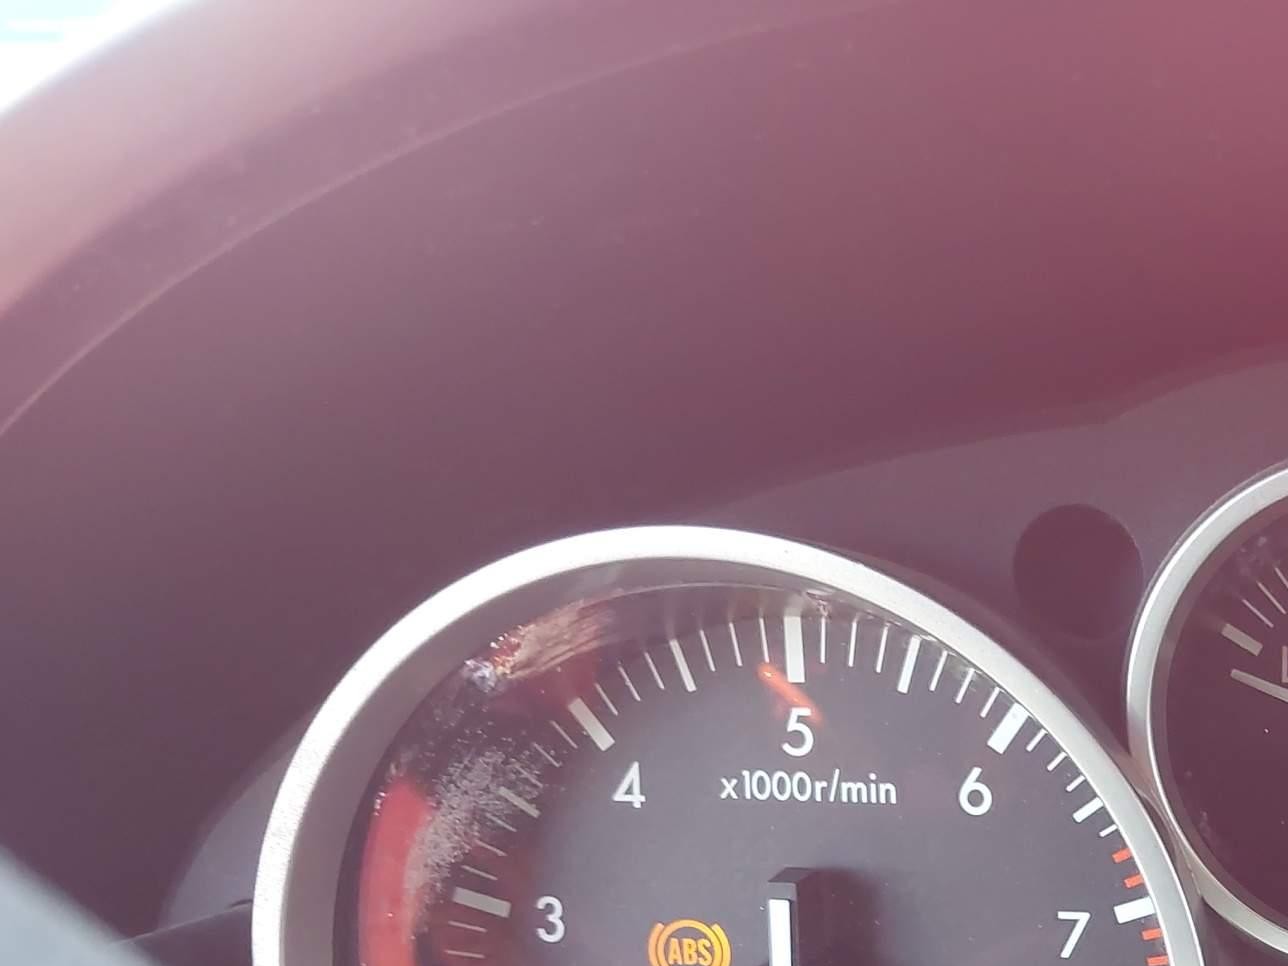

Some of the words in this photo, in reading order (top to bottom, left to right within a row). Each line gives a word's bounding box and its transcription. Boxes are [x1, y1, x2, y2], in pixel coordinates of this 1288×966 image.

[781, 708, 815, 757] 5
[612, 761, 646, 809] 4
[720, 768, 897, 805] x1000r/min
[959, 767, 993, 816] 6
[535, 896, 566, 943] 3
[1057, 911, 1091, 959] 7
